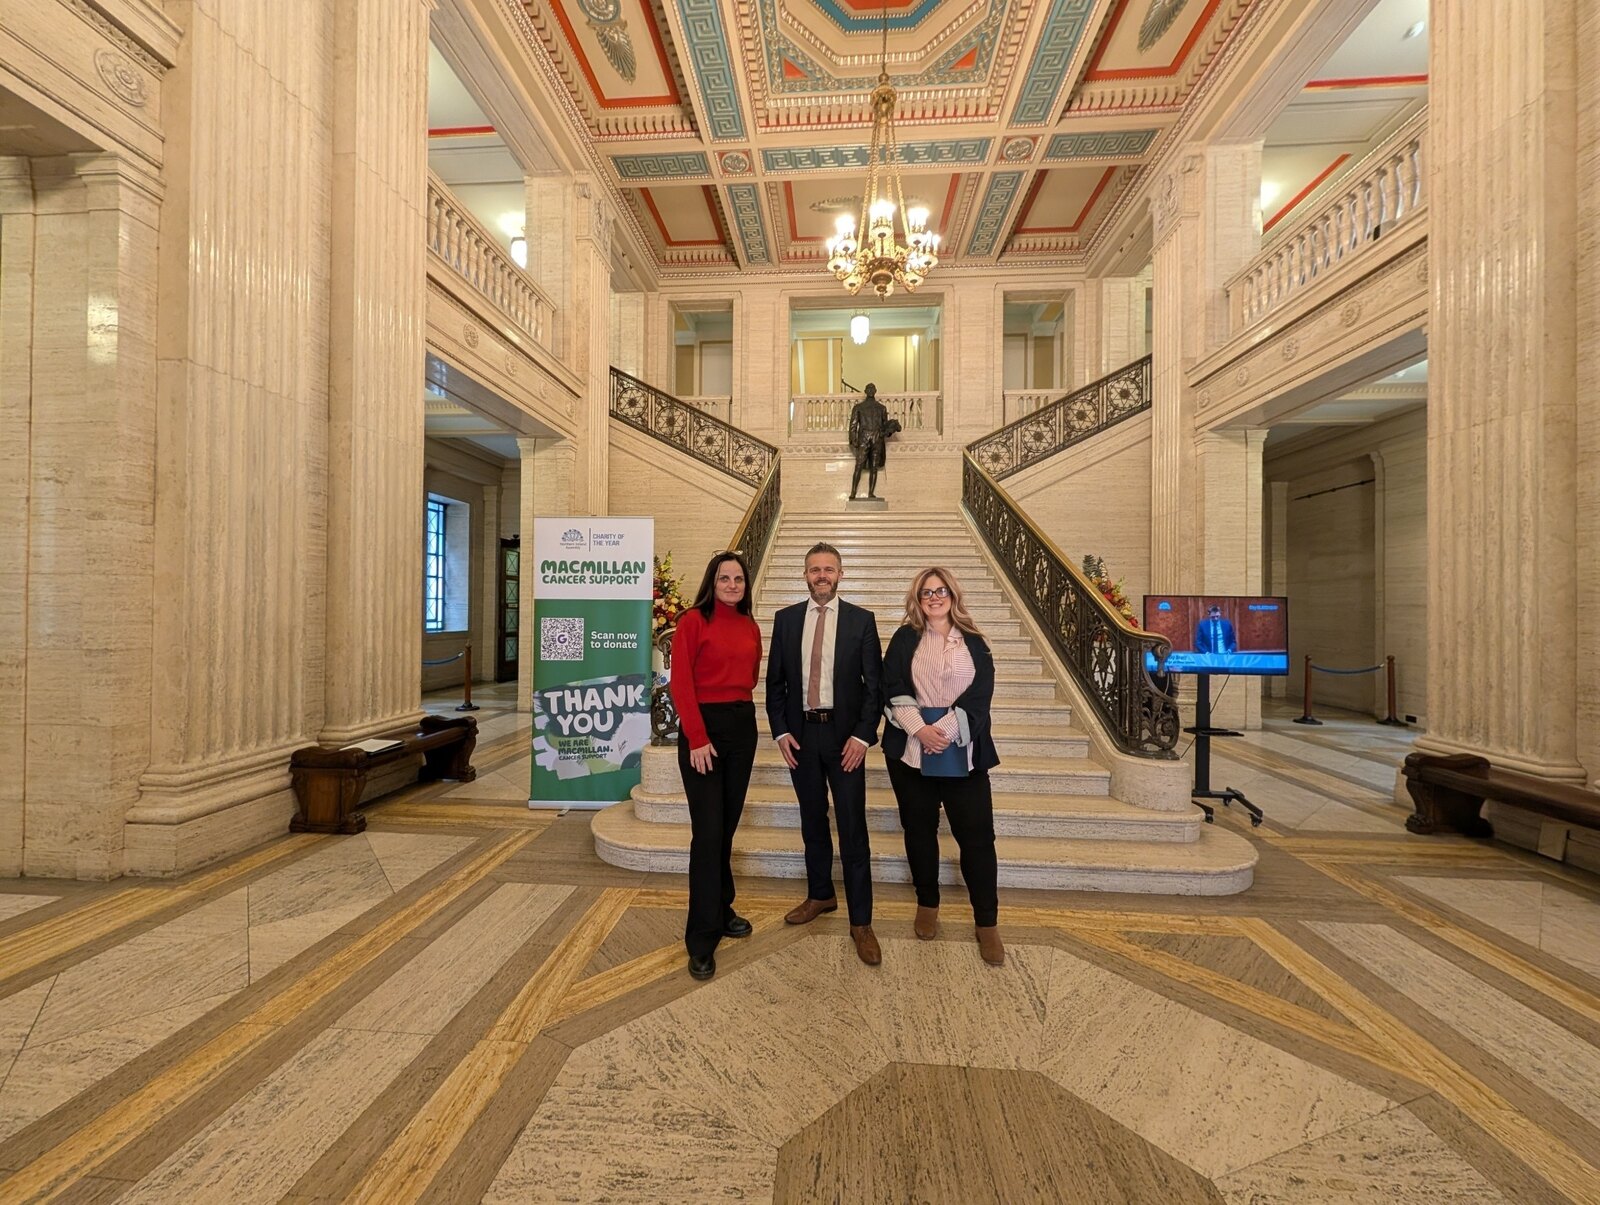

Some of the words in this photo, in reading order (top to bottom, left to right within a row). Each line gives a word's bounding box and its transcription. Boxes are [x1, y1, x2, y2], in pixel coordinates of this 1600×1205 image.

[540, 560, 646, 574] MACMILLAN
[542, 575, 586, 584] CANCER
[589, 575, 640, 584] SUPPORT
[591, 631, 614, 640] Scan
[590, 641, 601, 649] to
[603, 640, 638, 649] donate
[544, 684, 646, 714] THANK
[556, 710, 614, 735] YOU
